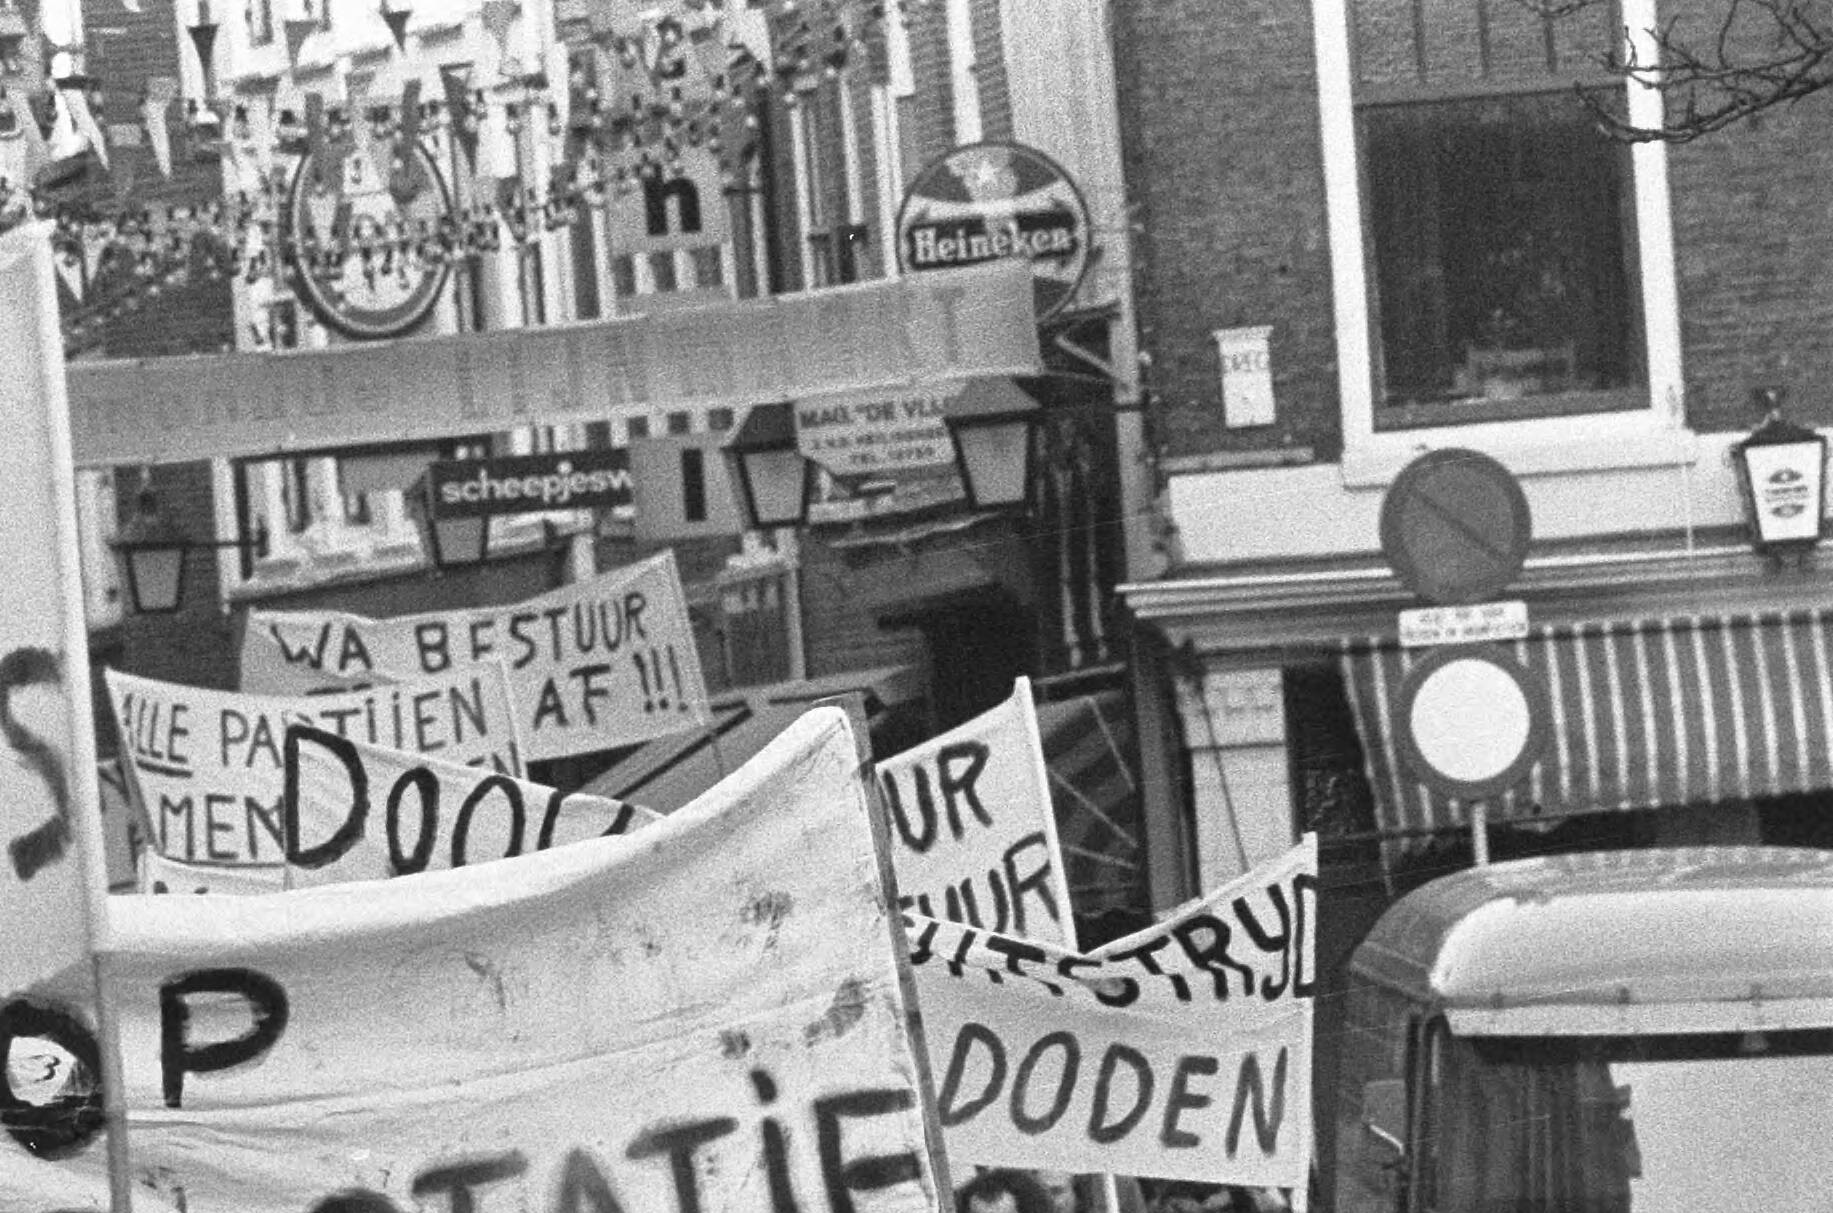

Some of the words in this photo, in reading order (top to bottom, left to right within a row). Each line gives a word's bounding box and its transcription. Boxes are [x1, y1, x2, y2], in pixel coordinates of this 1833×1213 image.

[913, 218, 1074, 264] Heineken
[415, 592, 648, 674] BESTUUR
[532, 663, 611, 730] AF
[939, 1022, 1288, 1160] DODEN
